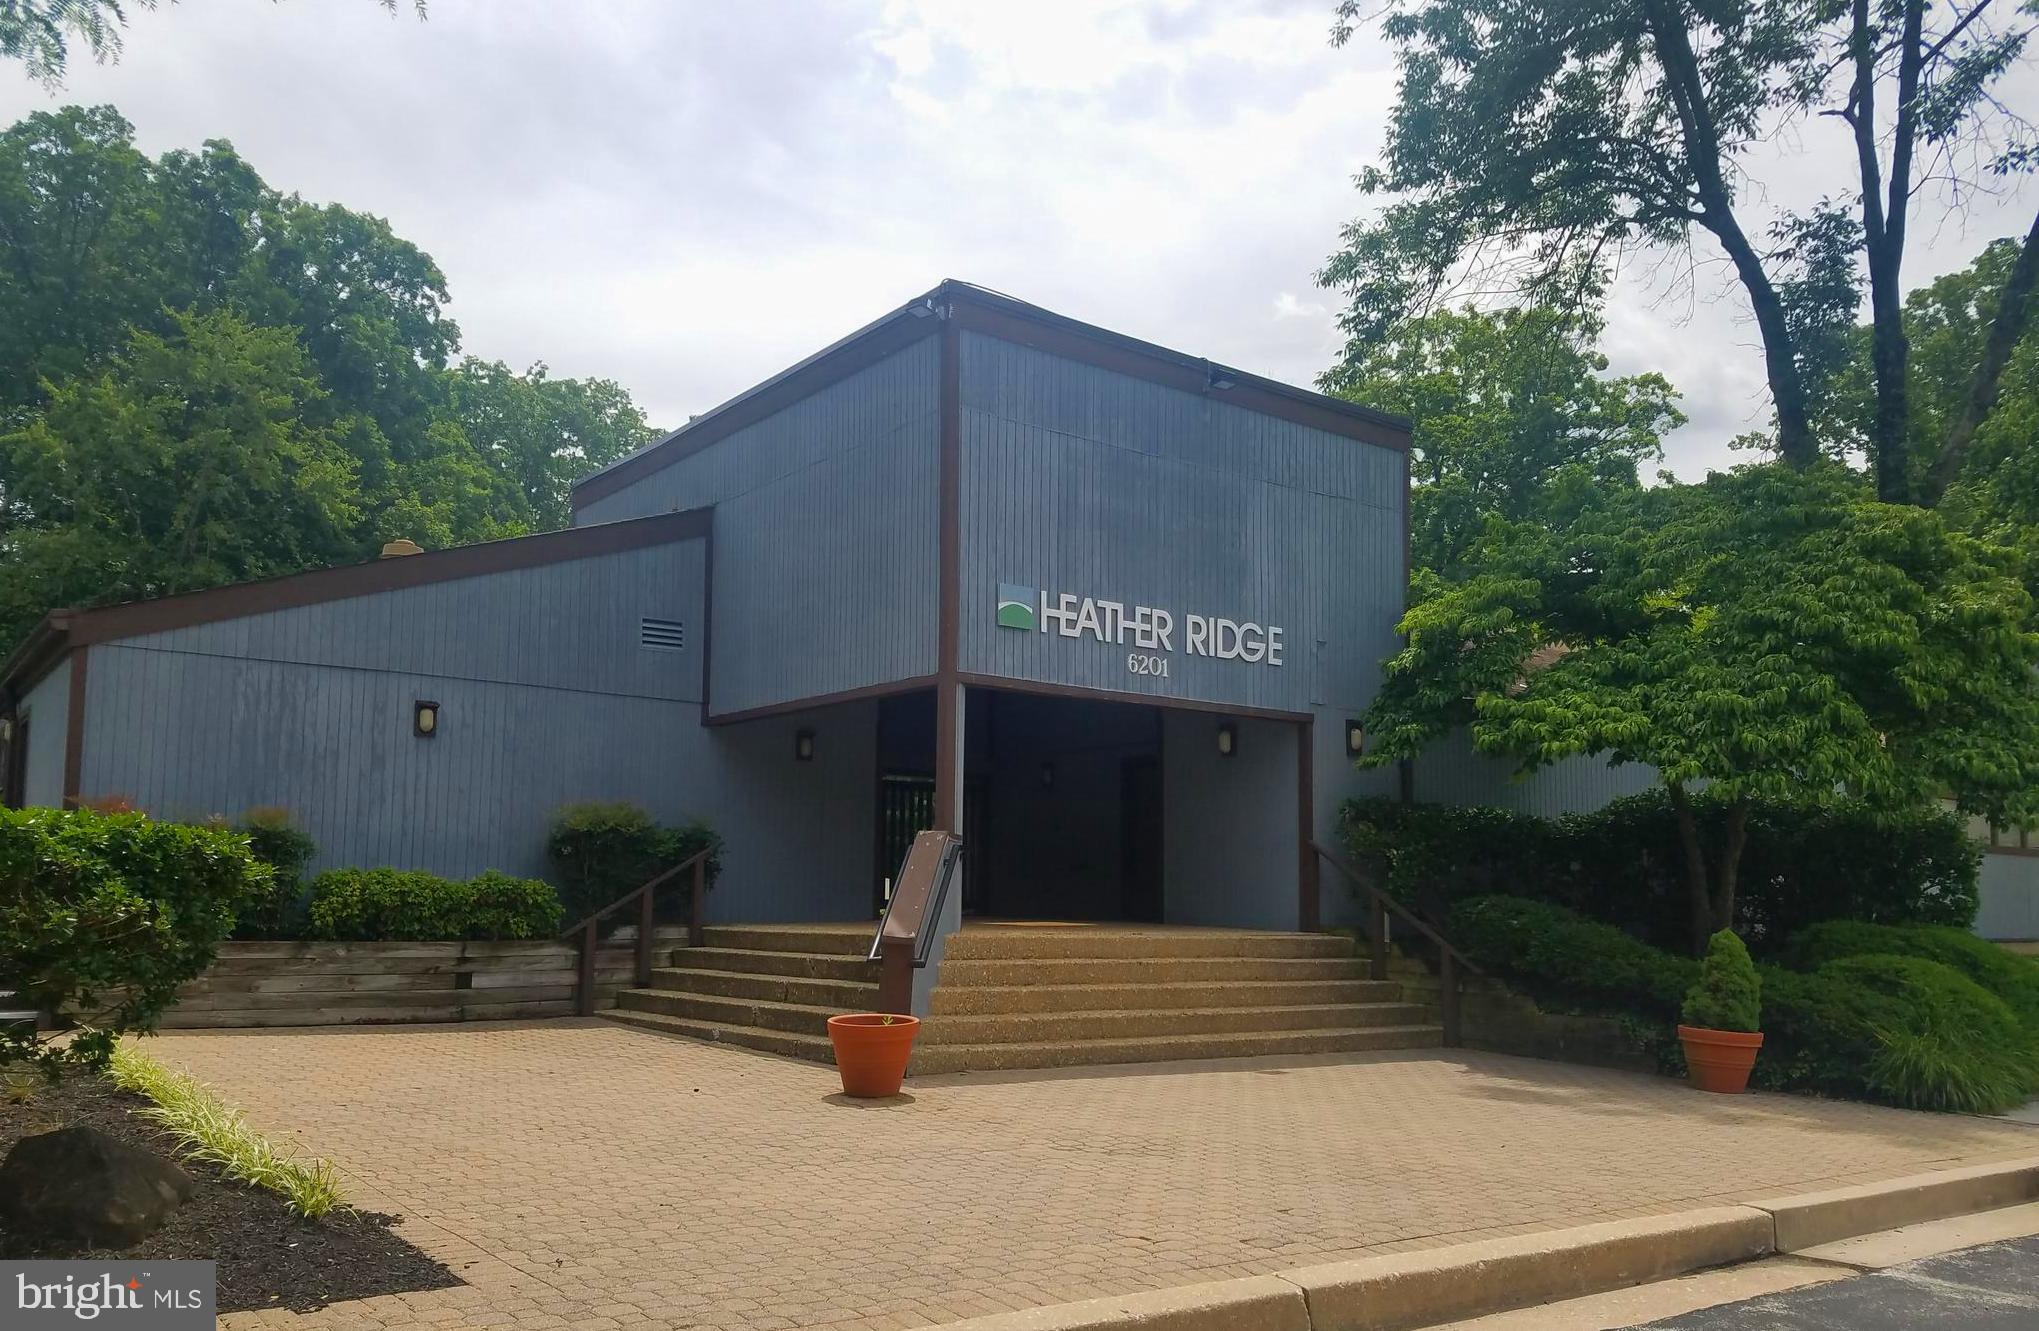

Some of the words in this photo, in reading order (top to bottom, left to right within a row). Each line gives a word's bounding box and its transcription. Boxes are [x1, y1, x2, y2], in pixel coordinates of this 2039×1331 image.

[1040, 590, 1174, 652] HEATHER
[1186, 613, 1284, 666] RIDGE
[1127, 653, 1169, 678] 6201
